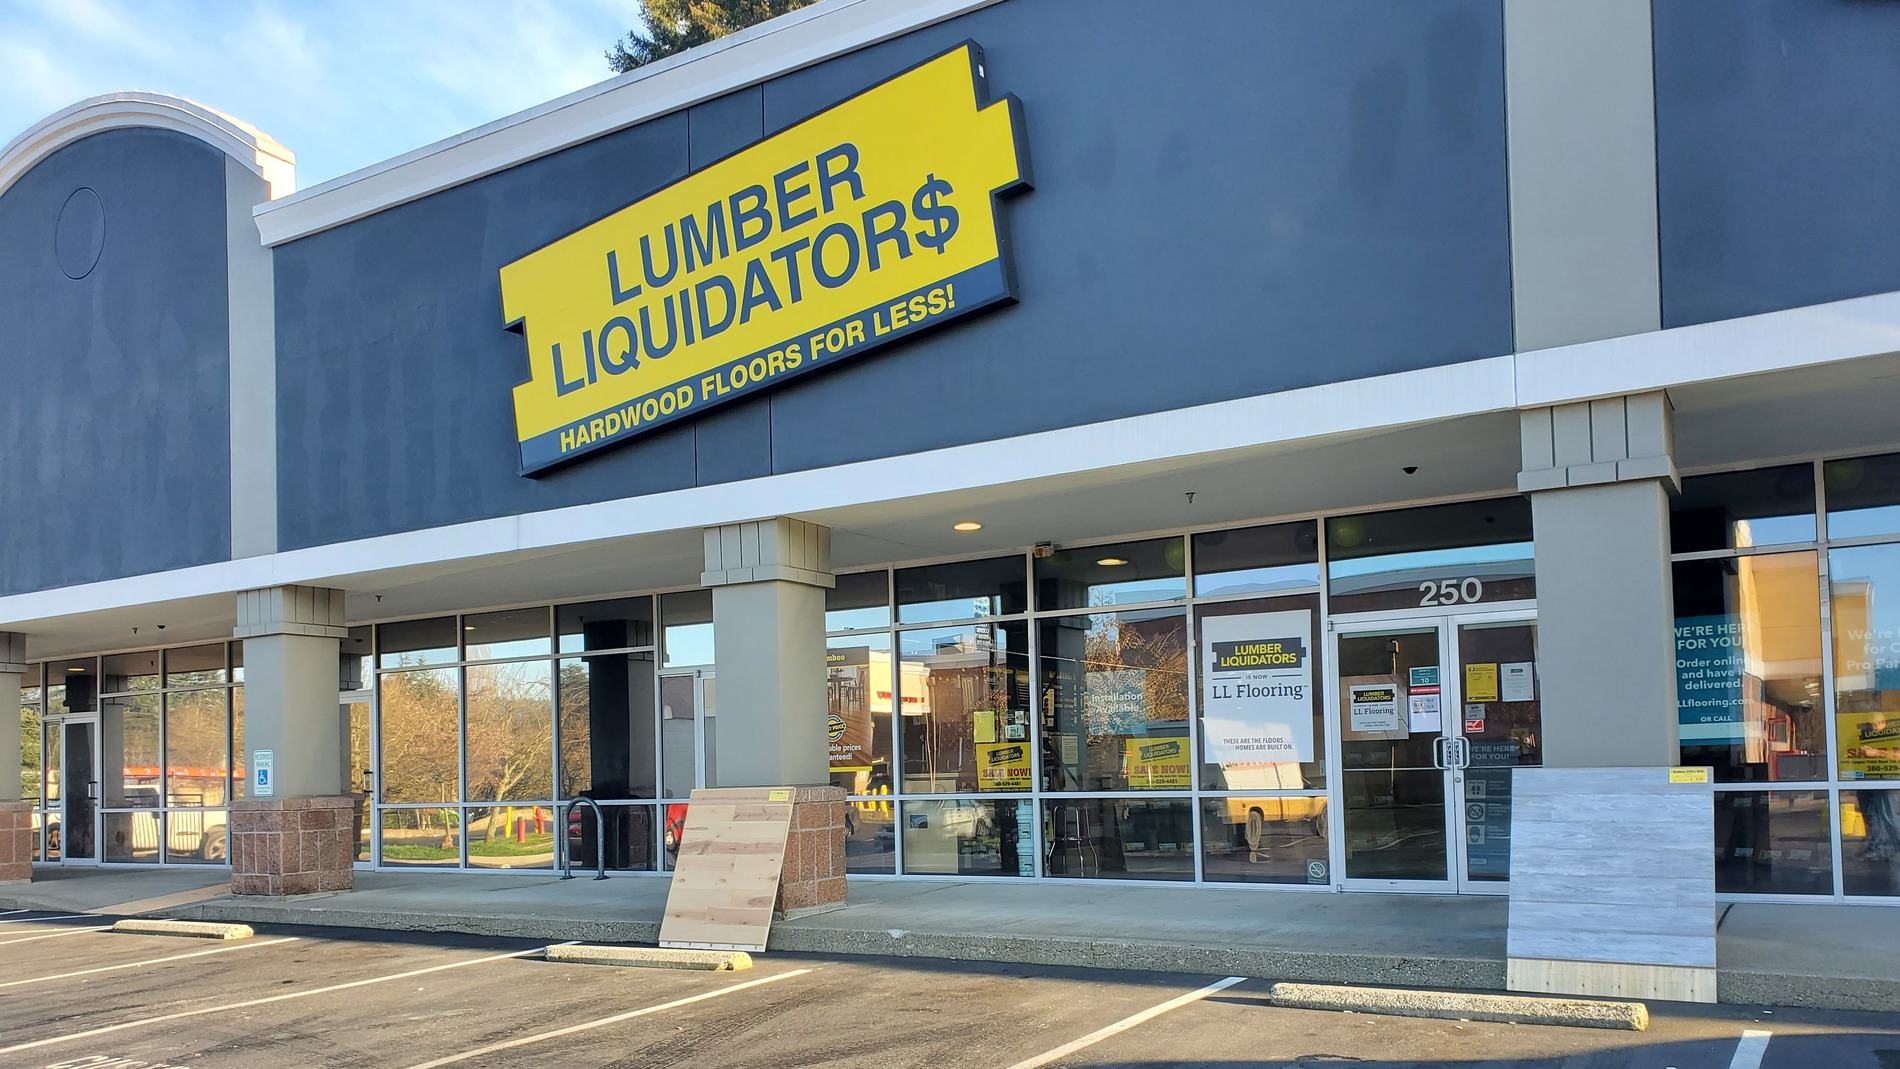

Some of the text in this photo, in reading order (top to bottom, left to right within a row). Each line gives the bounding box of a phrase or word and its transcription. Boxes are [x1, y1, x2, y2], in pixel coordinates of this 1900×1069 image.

[606, 142, 866, 306] LUMBER
[560, 284, 956, 453] HARDWOOD FLOORS FOR LESS!
[1419, 576, 1483, 606] 250
[1234, 643, 1282, 656] LUMBER
[1677, 639, 1707, 650] FOR
[1863, 643, 1886, 655] for
[1220, 652, 1297, 667] LIQUIDATORS
[1676, 656, 1744, 668] Order onlin
[1846, 659, 1873, 671] Pro
[1681, 669, 1704, 679] and
[1706, 668, 1735, 678] have
[1212, 685, 1232, 699] LL
[1357, 694, 1392, 702] LIQUIDATORS
[843, 744, 861, 754] prices
[1161, 764, 1190, 774] NOW!
